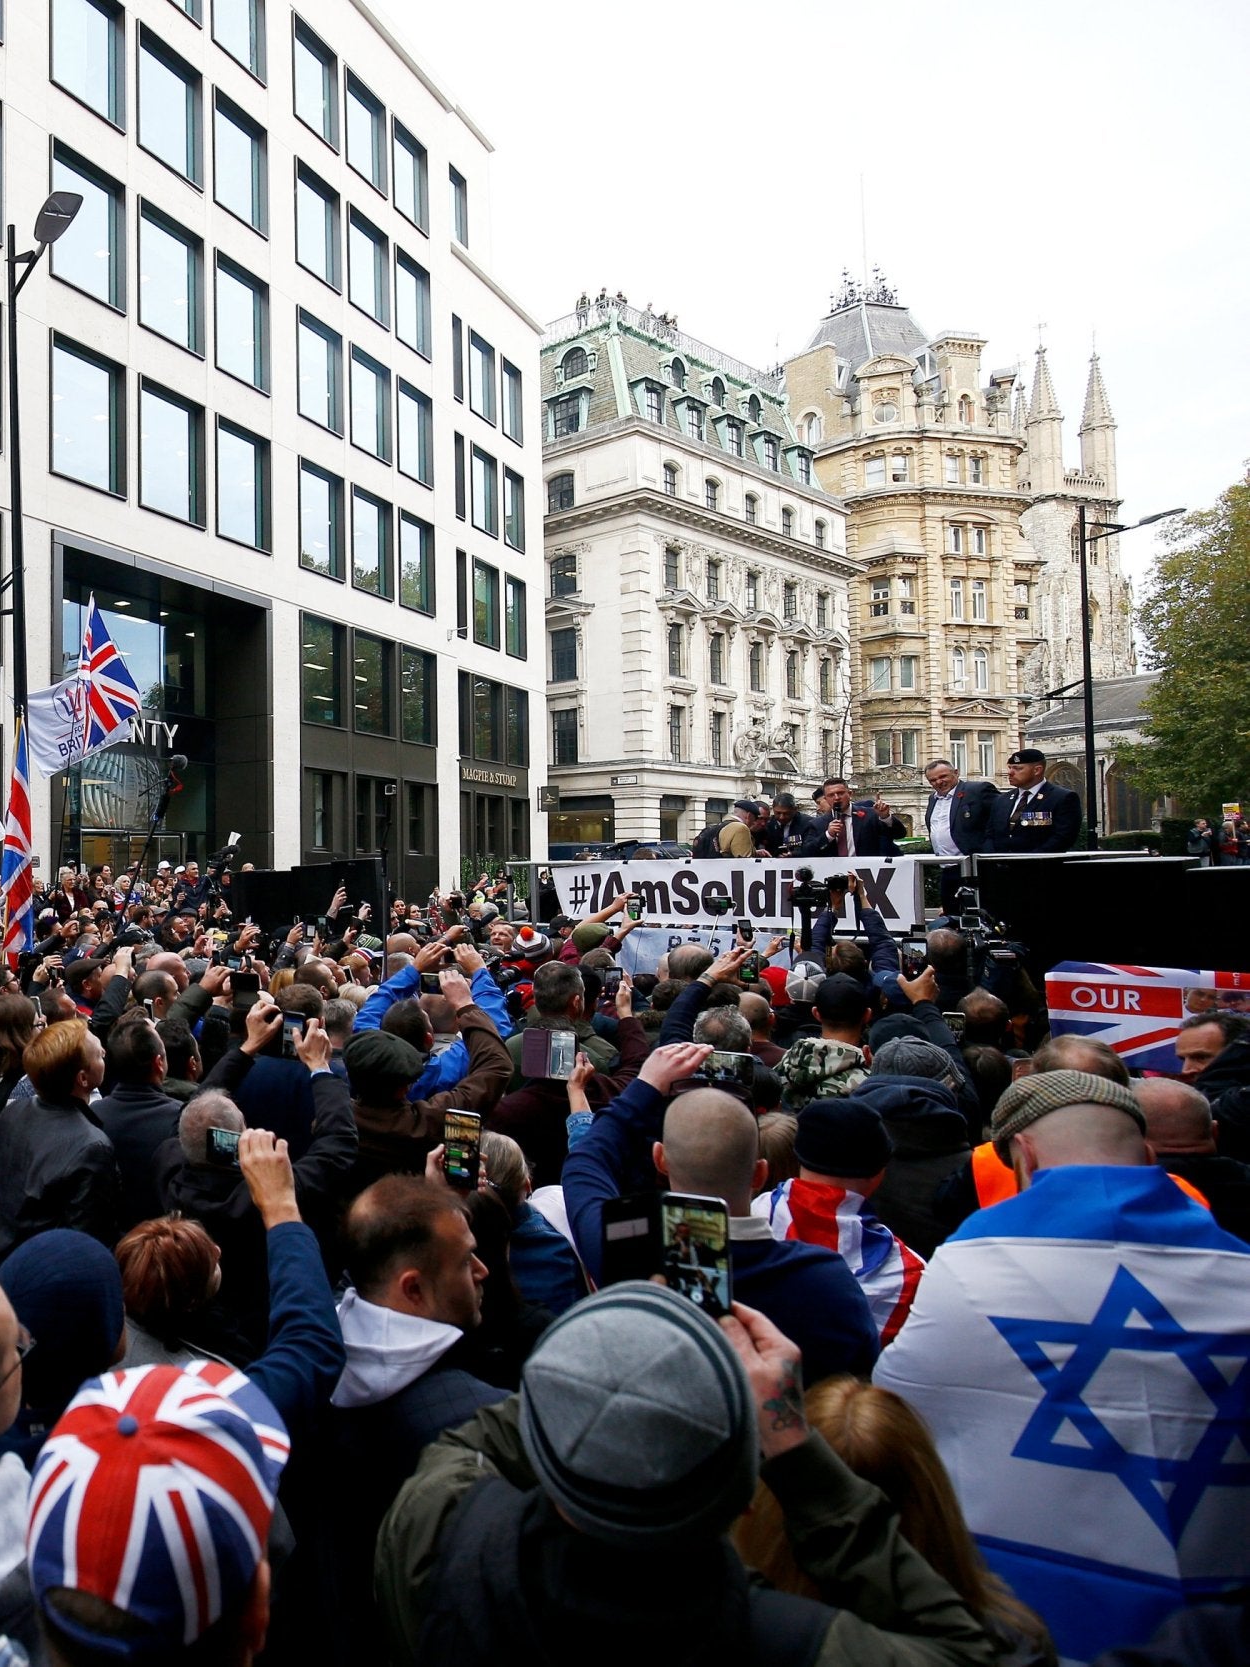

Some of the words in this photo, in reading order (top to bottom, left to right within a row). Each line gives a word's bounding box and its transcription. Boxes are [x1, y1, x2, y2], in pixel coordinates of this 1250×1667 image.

[121, 717, 179, 749] NTY
[462, 767, 488, 783] MAGPIE
[489, 772, 495, 784] &
[495, 772, 517, 787] STUMP
[569, 867, 900, 920] #IAmSoldiX
[1070, 986, 1142, 1011] OUR
